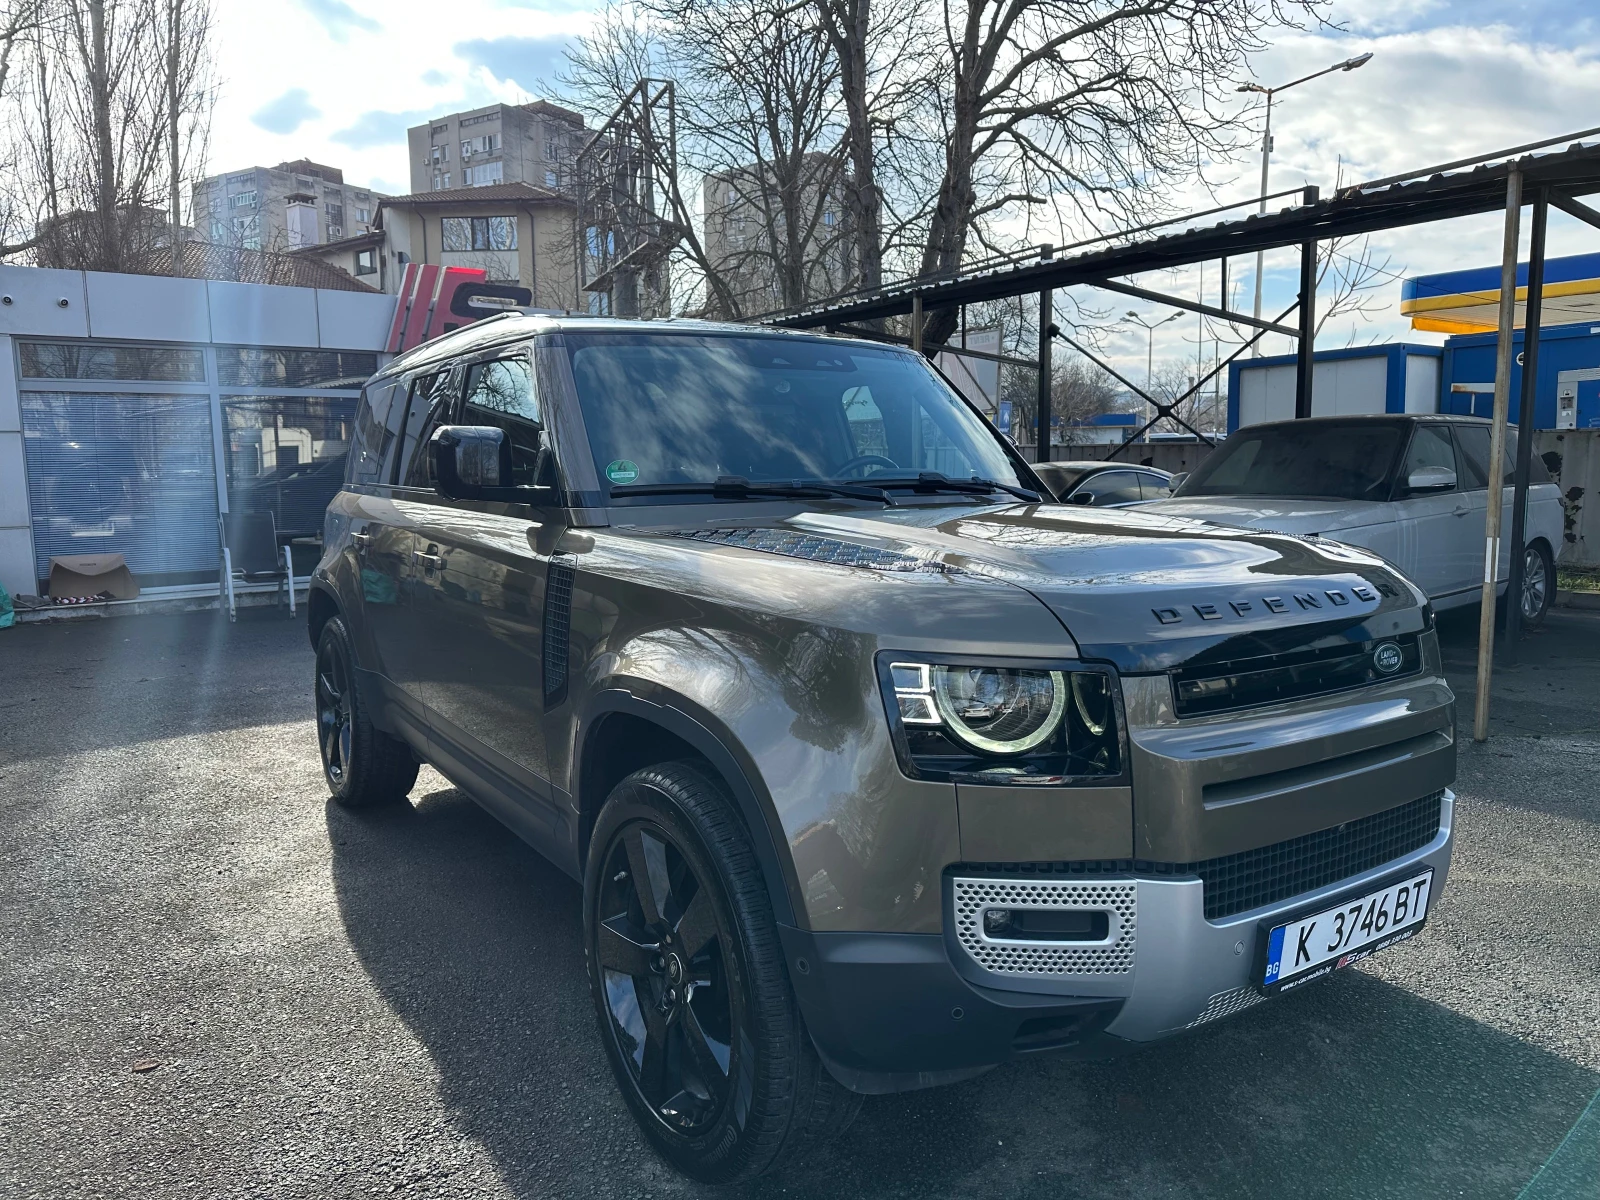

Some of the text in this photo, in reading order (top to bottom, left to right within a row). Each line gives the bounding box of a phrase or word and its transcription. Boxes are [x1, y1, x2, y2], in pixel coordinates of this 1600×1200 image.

[617, 461, 628, 472] 4
[1151, 582, 1399, 625] DEFENDER
[1380, 649, 1394, 659] LAND
[1382, 656, 1398, 665] ROVER
[1294, 921, 1317, 967] K
[1265, 961, 1280, 977] BG
